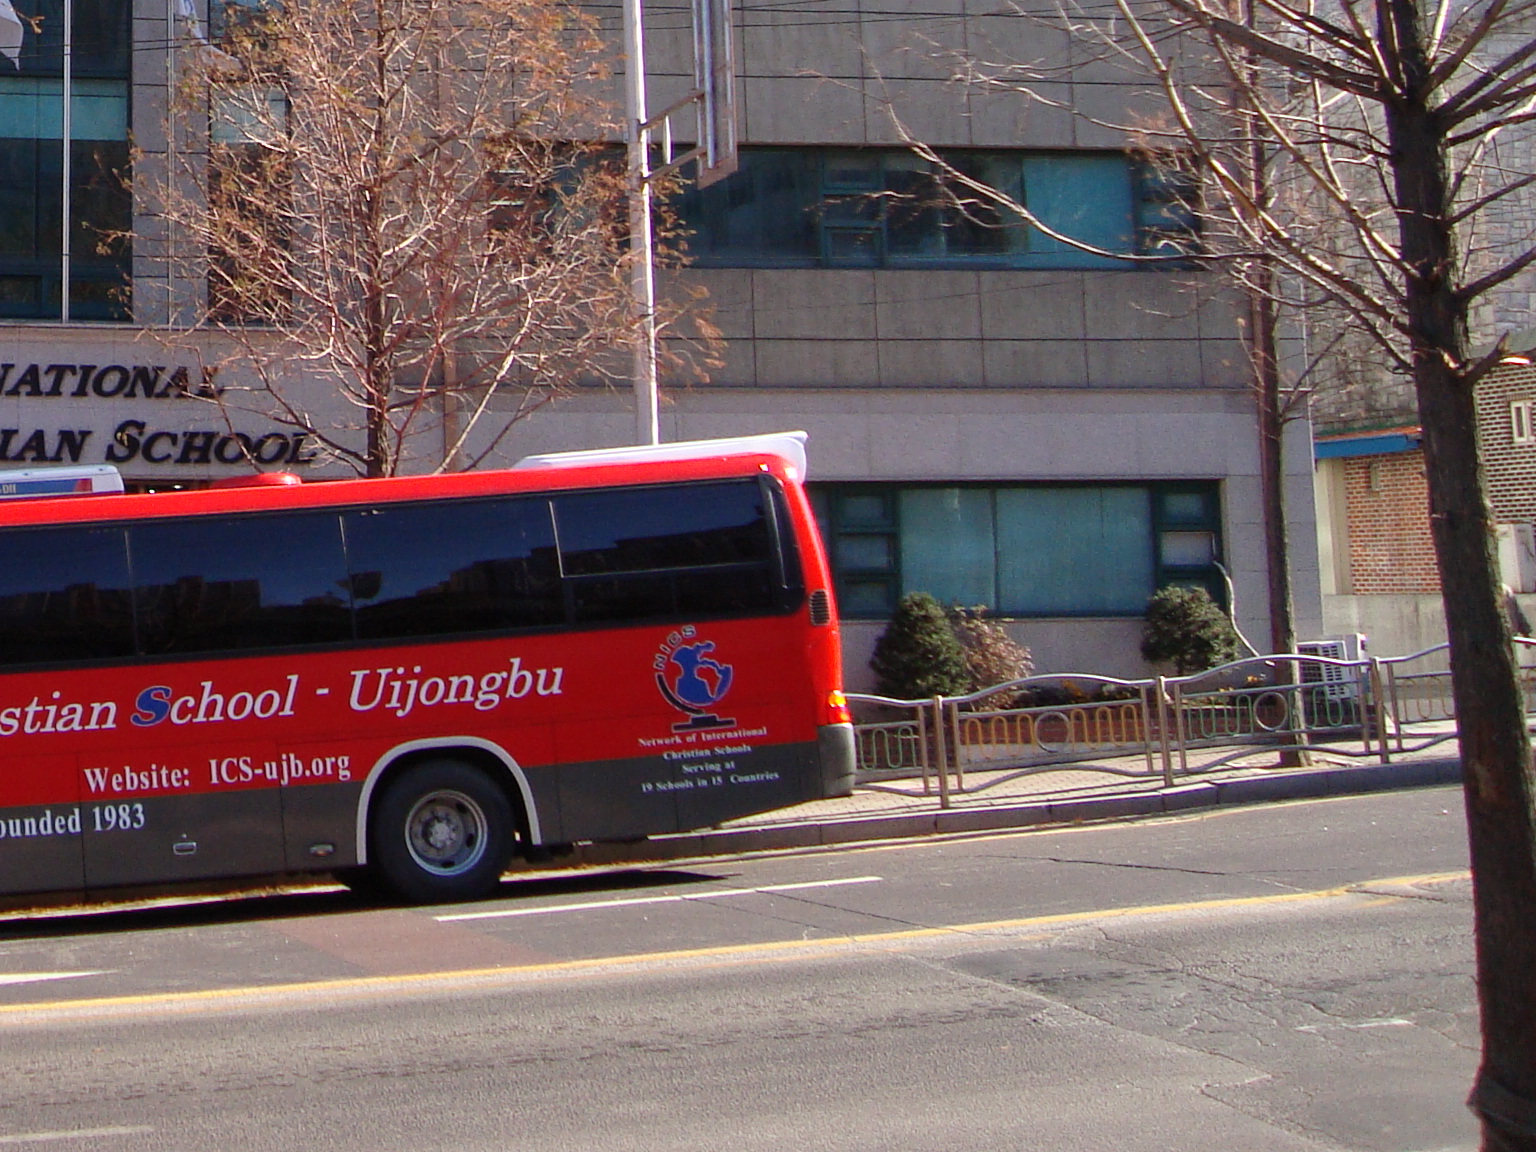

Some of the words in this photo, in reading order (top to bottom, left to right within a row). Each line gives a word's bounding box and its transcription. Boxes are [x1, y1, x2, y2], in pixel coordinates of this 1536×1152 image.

[105, 419, 317, 464] SCHOOL
[130, 675, 300, 727] School
[348, 658, 564, 716] Uijongbu
[638, 735, 682, 747] Network
[685, 733, 697, 743] of
[701, 726, 768, 742] International
[663, 748, 711, 761] Christian
[714, 744, 752, 755] Schools
[84, 765, 190, 793] Website:
[208, 753, 351, 786] ICS-ujb.org
[682, 762, 722, 774] Serving
[724, 760, 736, 769] at
[655, 778, 694, 791] Schools
[696, 777, 708, 787] in
[729, 771, 780, 785] Countries
[92, 803, 146, 832] 1983
